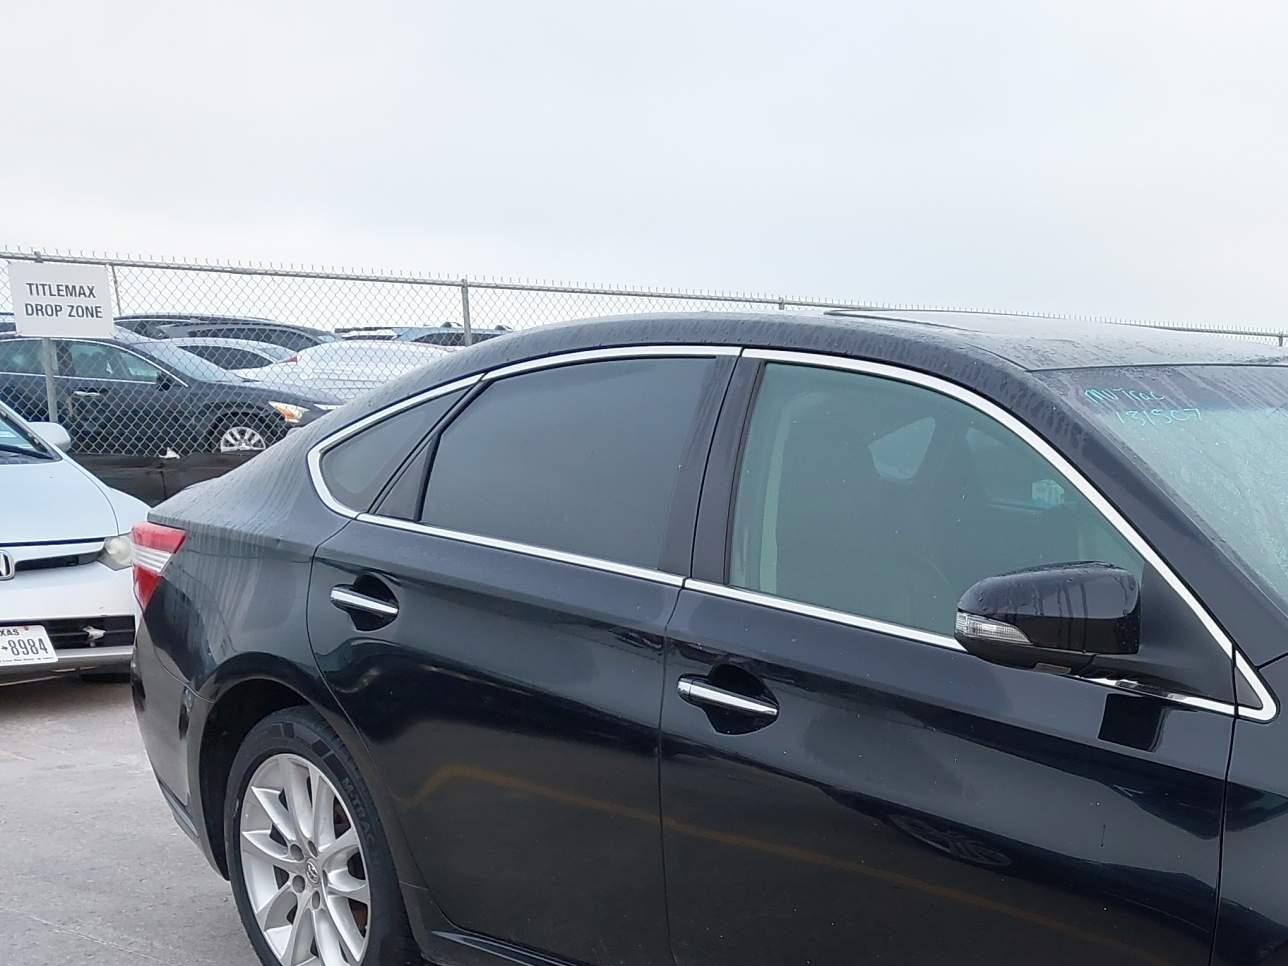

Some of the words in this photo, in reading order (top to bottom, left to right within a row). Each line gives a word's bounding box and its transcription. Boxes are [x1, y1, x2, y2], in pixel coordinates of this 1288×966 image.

[26, 282, 97, 299] TITLEMAX
[25, 303, 63, 317] DROP
[67, 304, 104, 319] ZONE
[8, 638, 49, 656] 8984
